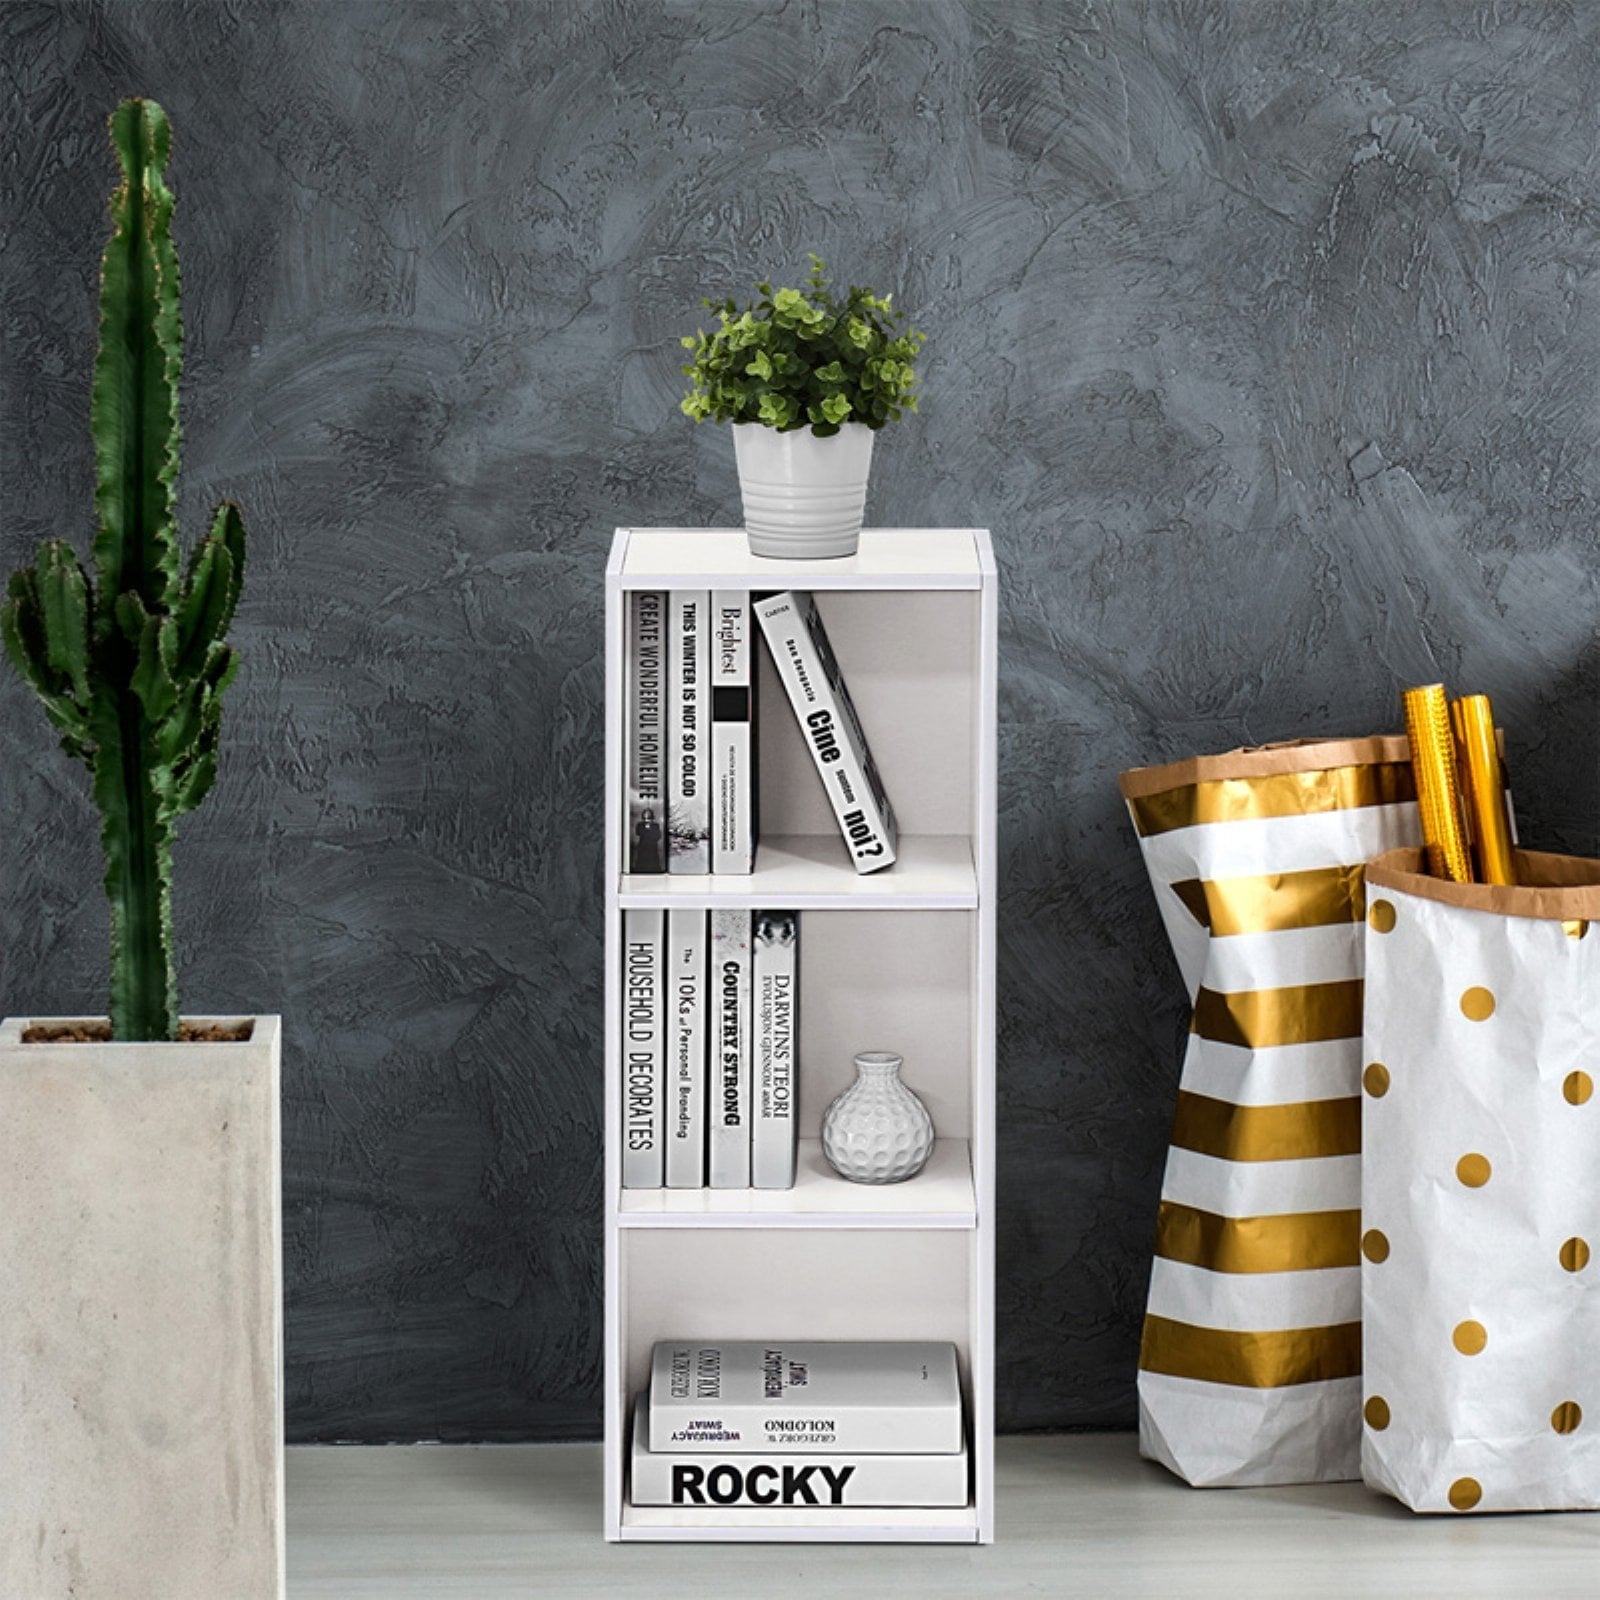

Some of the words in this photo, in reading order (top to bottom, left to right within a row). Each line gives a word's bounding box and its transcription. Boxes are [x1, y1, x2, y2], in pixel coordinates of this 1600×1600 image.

[640, 594, 658, 641] CREATE
[683, 602, 696, 632] THIS
[716, 608, 742, 674] Brightest
[683, 635, 696, 684] WINTER
[640, 645, 658, 728] WONDERFUL
[683, 688, 696, 701] IS
[683, 705, 696, 730] NOT
[683, 734, 696, 752] SO
[639, 733, 658, 799] HOMELIFE
[683, 755, 696, 797] COLOD
[806, 709, 841, 763] Cine
[843, 809, 884, 858] noi?
[683, 949, 692, 963] The
[629, 943, 654, 1042] HOUSEHOLD
[679, 975, 696, 1014] 10Ks
[723, 961, 740, 1049] COUNTRY
[774, 975, 790, 1060] DARWINS
[679, 1029, 692, 1082] Personal
[629, 1053, 654, 1150] DECORATES
[676, 1087, 691, 1138] Branding
[724, 1053, 740, 1126] STRONG
[773, 1064, 790, 1119] TEORI
[672, 1464, 856, 1504] ROCKY
